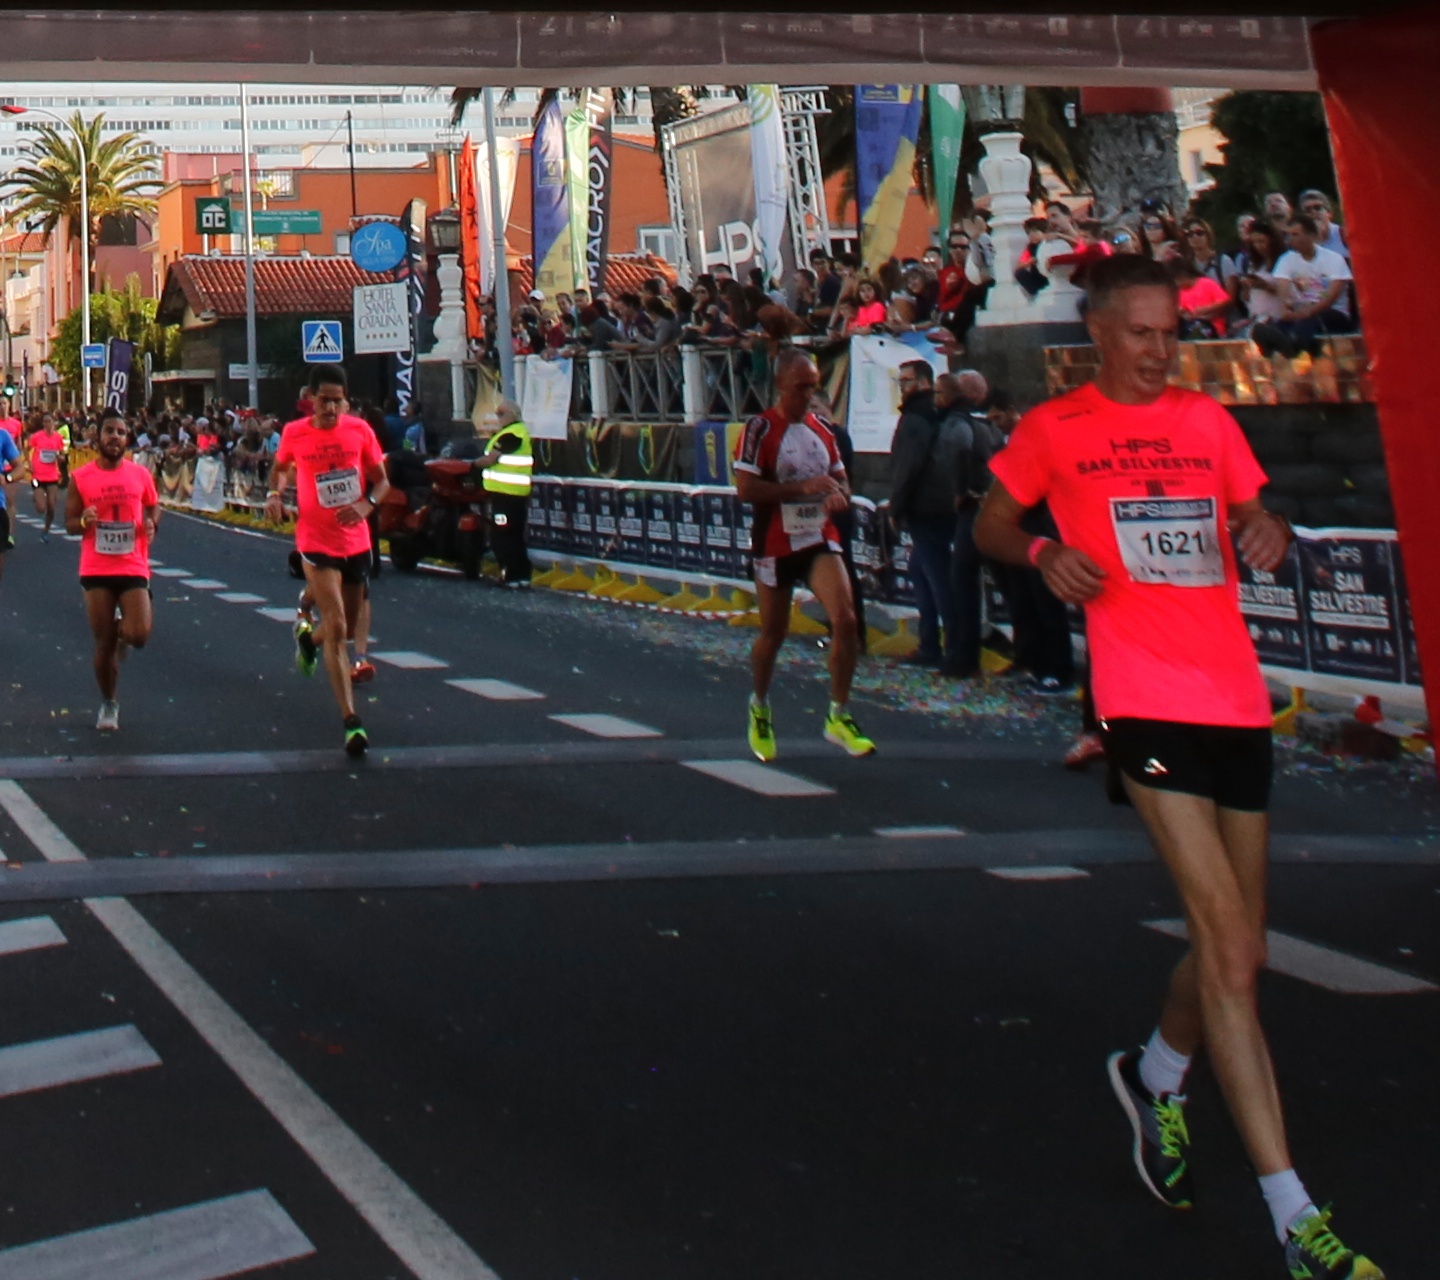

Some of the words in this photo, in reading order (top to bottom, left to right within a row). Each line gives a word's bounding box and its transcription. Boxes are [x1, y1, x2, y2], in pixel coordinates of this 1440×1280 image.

[363, 288, 395, 302] HOTEL
[364, 301, 397, 314] SANTA
[359, 315, 404, 330] CATALINA
[1110, 438, 1173, 454] HPS
[1077, 458, 1112, 474] SAN
[1120, 457, 1214, 470] SILVESTRE
[327, 482, 352, 494] 1501
[1117, 503, 1161, 517] HPS
[1142, 530, 1205, 555] 1621
